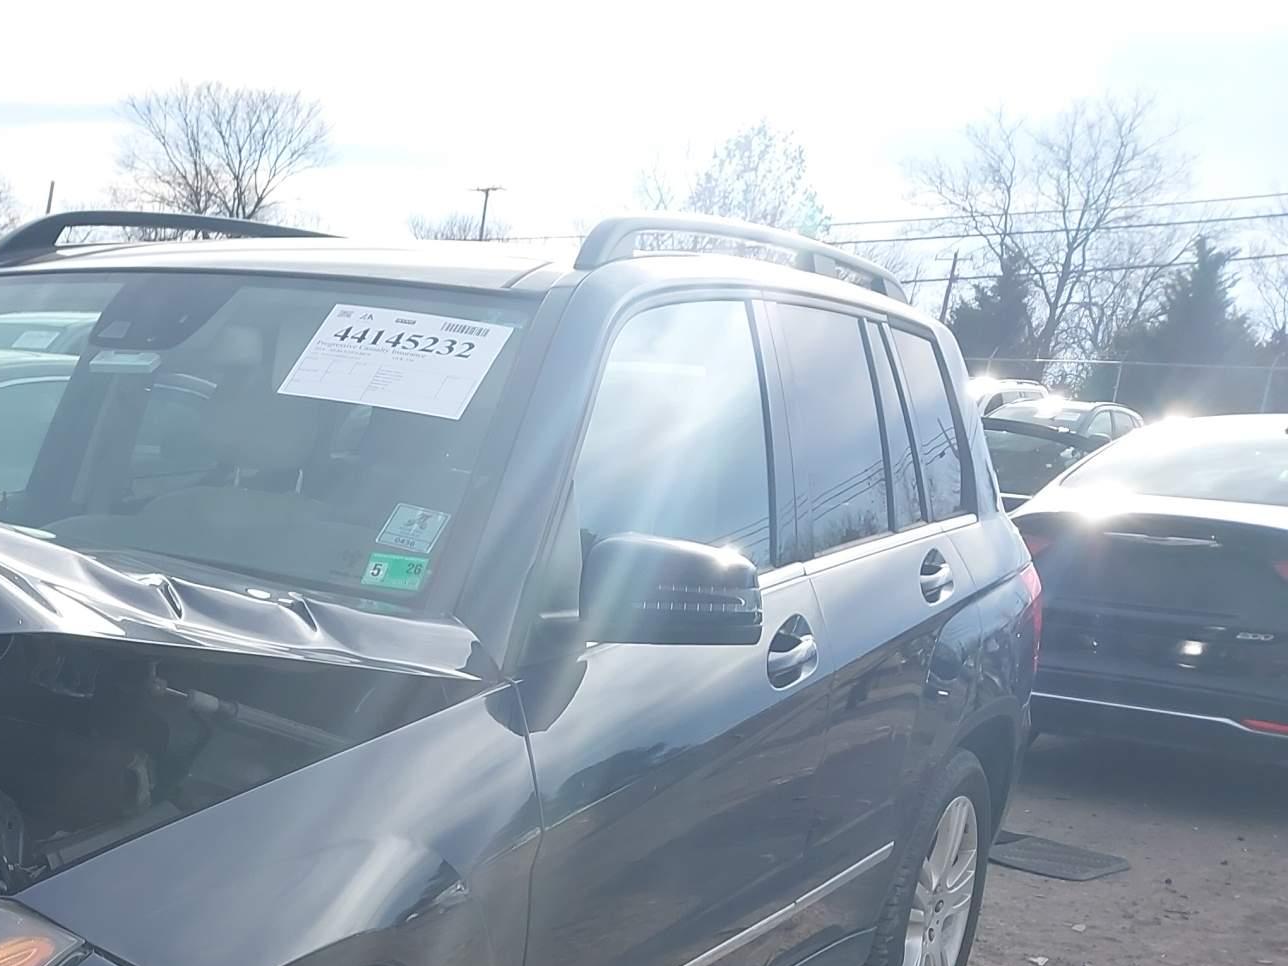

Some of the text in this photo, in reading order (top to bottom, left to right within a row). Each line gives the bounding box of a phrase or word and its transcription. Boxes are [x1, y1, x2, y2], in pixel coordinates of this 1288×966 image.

[333, 326, 476, 359] 44145232
[370, 562, 423, 577] 5 26
